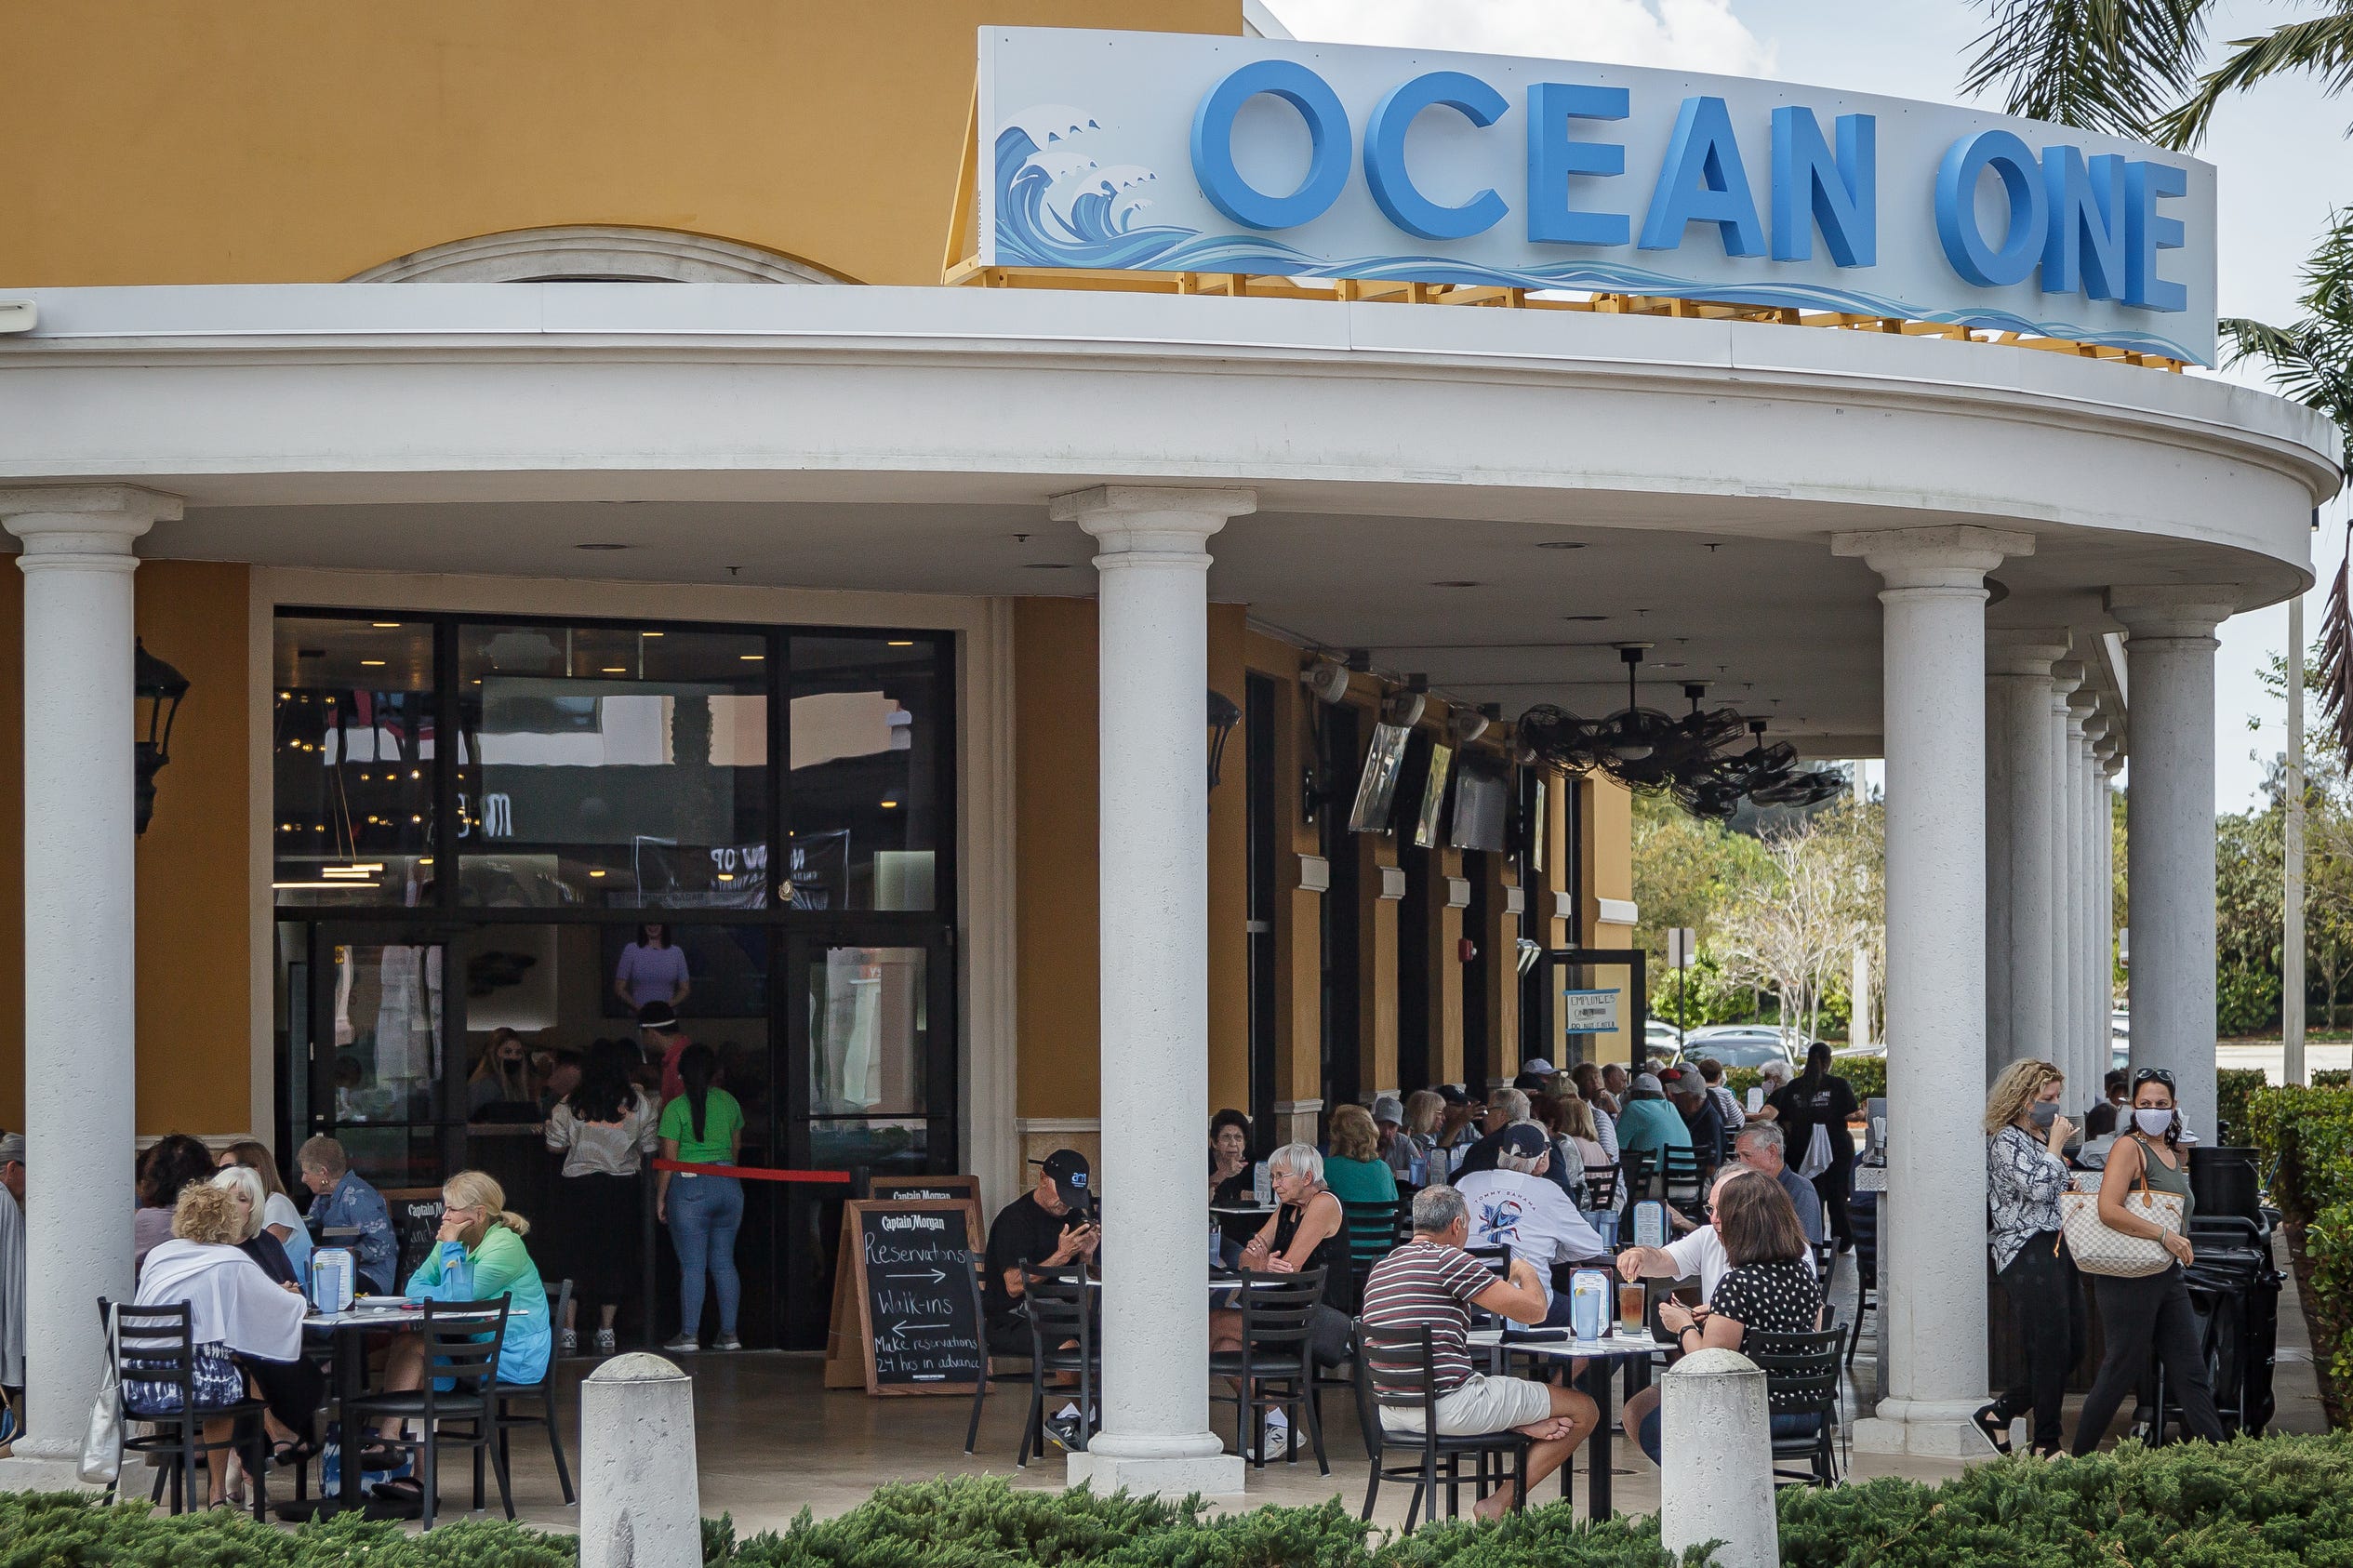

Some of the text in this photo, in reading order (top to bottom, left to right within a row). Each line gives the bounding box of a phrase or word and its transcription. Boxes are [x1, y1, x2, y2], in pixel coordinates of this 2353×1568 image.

[1190, 59, 2187, 312] OCEAN ONE
[1474, 1189, 1536, 1212] TOMMY BAHAMA
[407, 1202, 434, 1219] Captain
[881, 1214, 946, 1232] Captain Morgan
[877, 1289, 953, 1315] Walk-ins
[874, 1335, 978, 1354] Make reservations
[876, 1357, 895, 1373] 24
[899, 1354, 918, 1372] hrs
[923, 1358, 934, 1370] in
